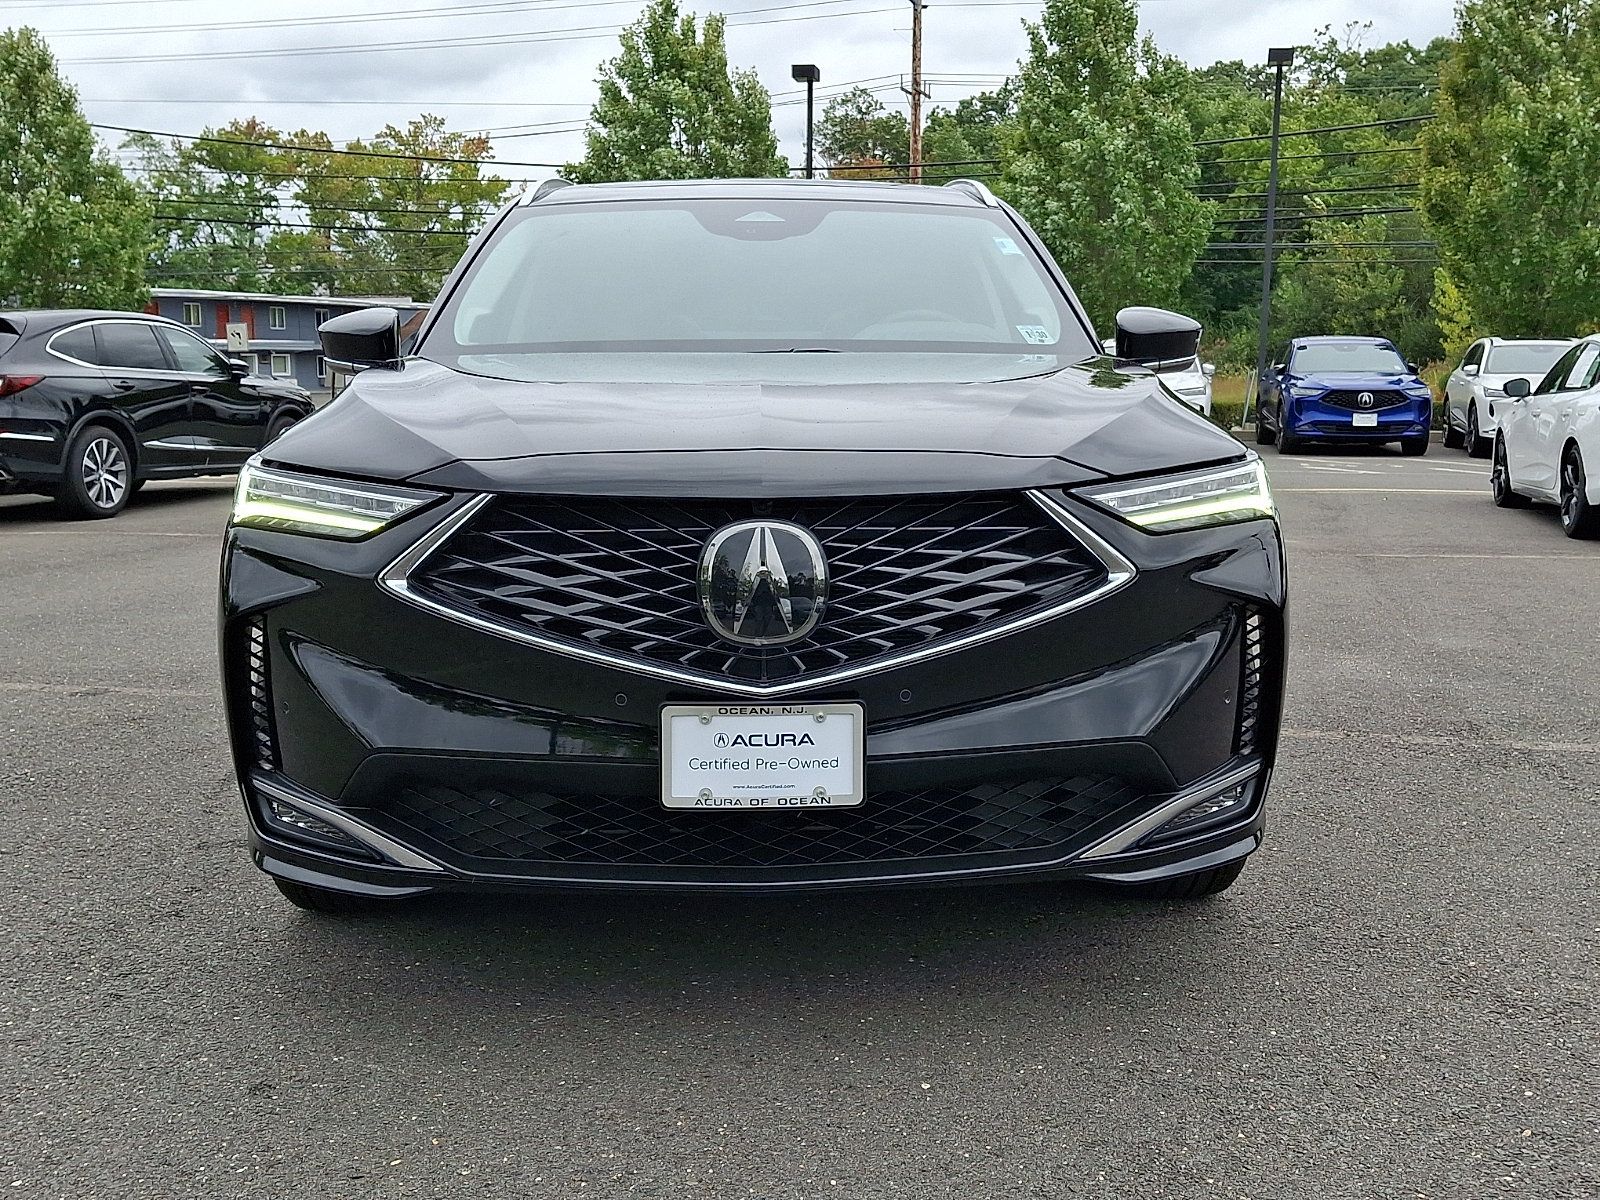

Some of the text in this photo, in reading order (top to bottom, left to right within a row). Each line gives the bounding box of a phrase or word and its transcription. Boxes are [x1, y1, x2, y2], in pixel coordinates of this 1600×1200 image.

[781, 706, 808, 714] N.J.
[731, 733, 815, 747] ACURA
[688, 756, 839, 770] Certified Pre-Owned
[694, 797, 831, 806] ACURA OF OCEAN
